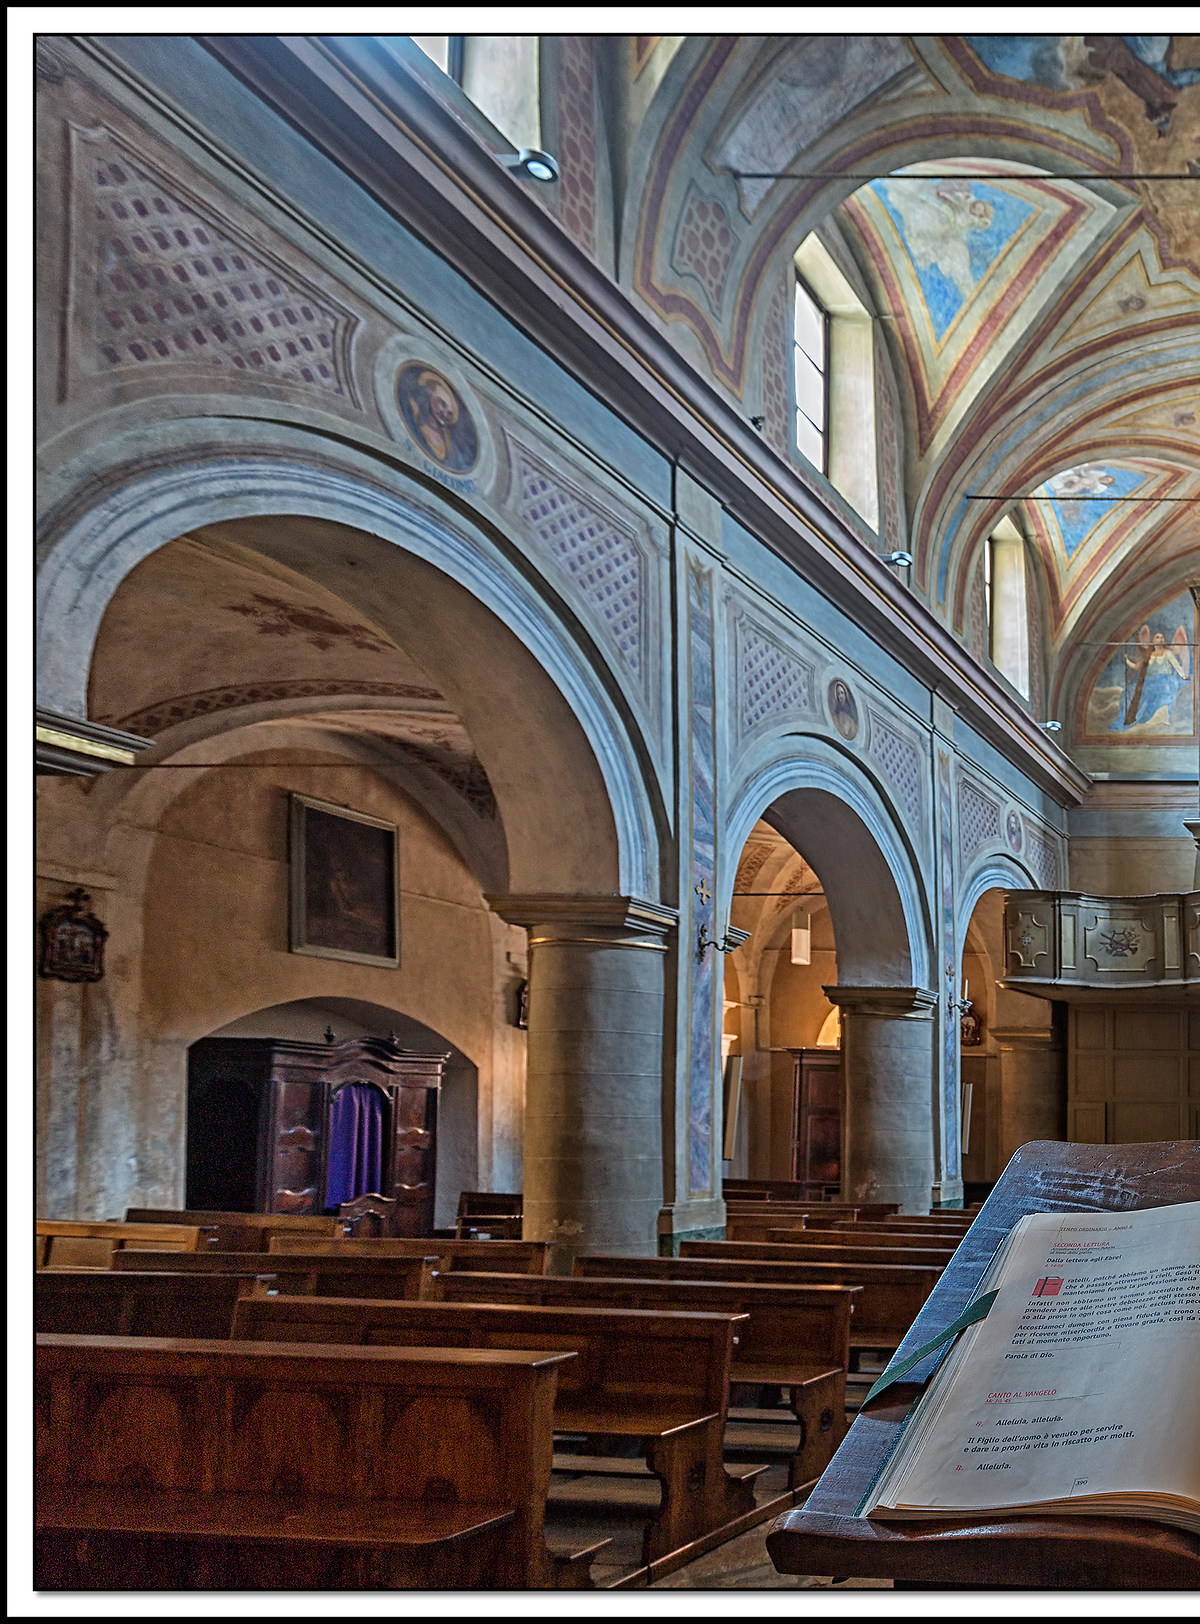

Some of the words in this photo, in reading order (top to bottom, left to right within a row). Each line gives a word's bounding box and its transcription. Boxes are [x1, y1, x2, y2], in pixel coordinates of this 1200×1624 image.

[1093, 1273, 1116, 1281] poiché
[1148, 1286, 1183, 1295] sacerdote
[1072, 1333, 1111, 1342] opportuno.
[1025, 1389, 1057, 1397] VANGELO
[1031, 1415, 1064, 1423] alleluia.
[1051, 1430, 1078, 1439] venuto
[1080, 1428, 1094, 1436] per
[1095, 1424, 1123, 1433] servire
[1000, 1443, 1030, 1453] propria
[1062, 1437, 1092, 1446] riscatto
[1094, 1434, 1108, 1443] per
[1110, 1431, 1135, 1439] molti.
